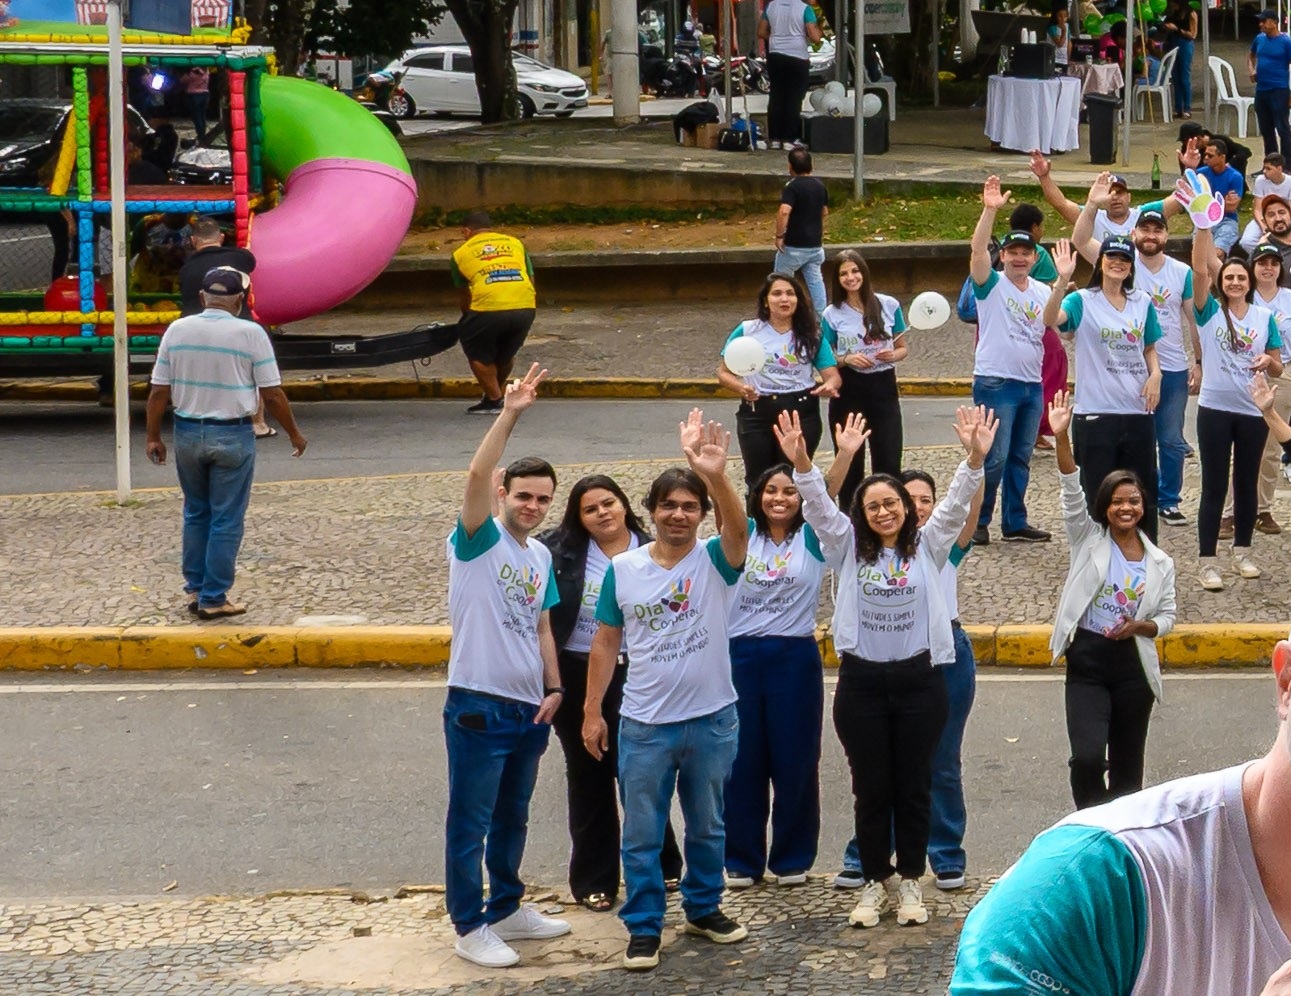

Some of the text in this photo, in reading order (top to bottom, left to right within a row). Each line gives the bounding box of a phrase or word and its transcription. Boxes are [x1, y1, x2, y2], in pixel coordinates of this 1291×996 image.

[745, 572, 796, 588] Cooperar
[857, 565, 882, 582] Dia
[863, 582, 917, 598] Cooperar
[634, 600, 664, 619] Dia
